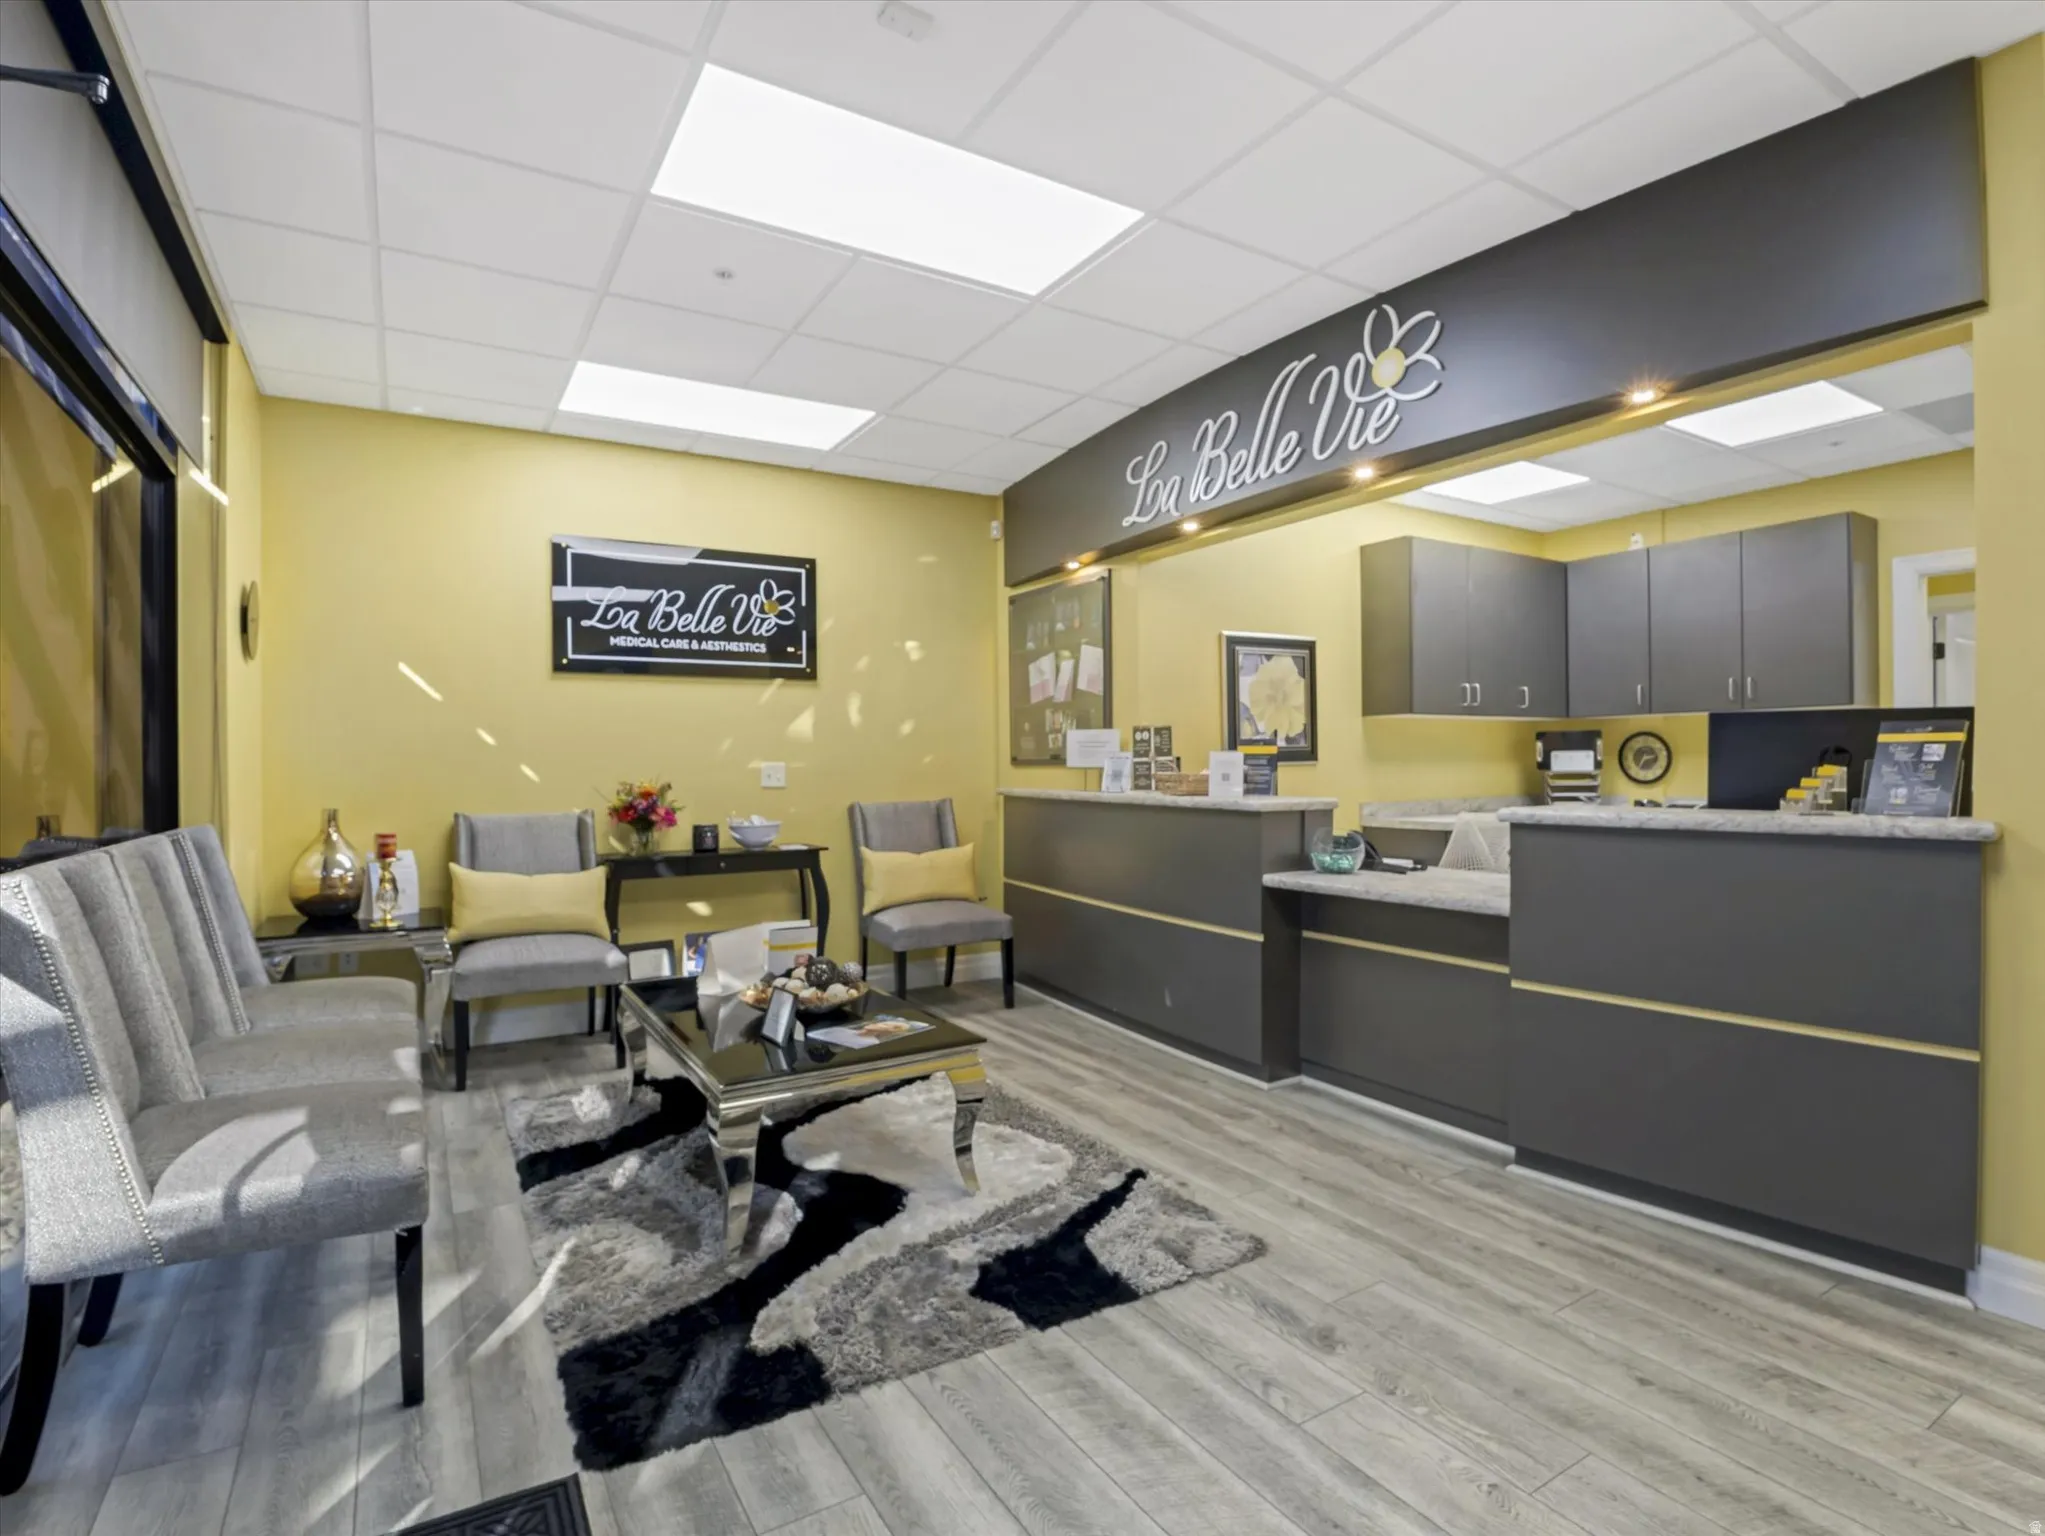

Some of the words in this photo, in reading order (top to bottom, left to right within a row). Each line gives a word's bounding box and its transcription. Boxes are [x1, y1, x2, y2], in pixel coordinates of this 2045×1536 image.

[1122, 440, 1184, 526] La
[1189, 353, 1317, 503] Belle
[1309, 351, 1401, 460] Vie
[580, 585, 641, 635] La
[647, 583, 736, 635] Belle
[731, 592, 778, 637] Vie
[609, 636, 659, 648] MEDICAL
[660, 638, 690, 650] CARE
[690, 639, 698, 650] &
[700, 640, 767, 653] AESTHESTICS
